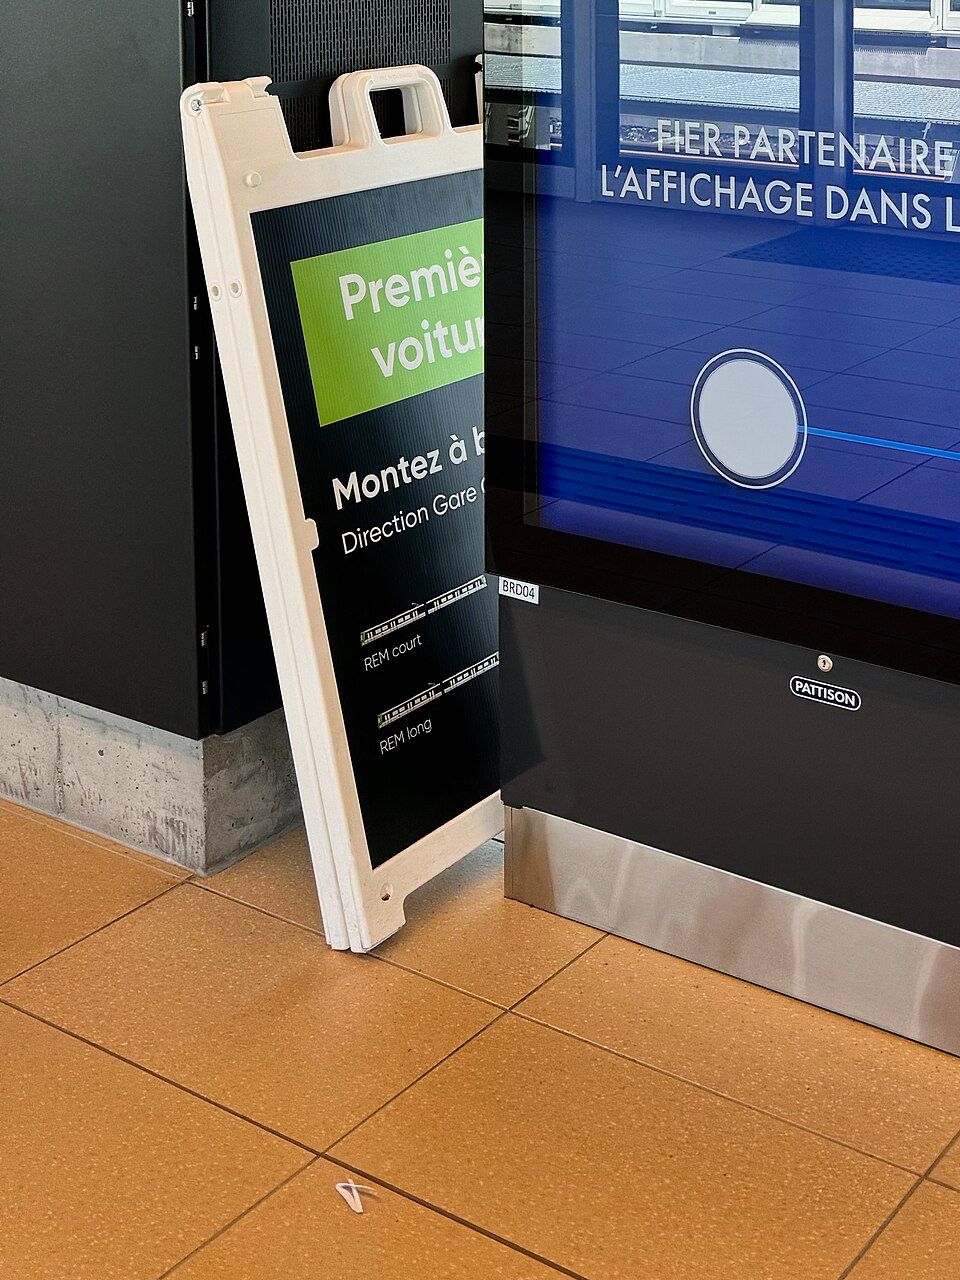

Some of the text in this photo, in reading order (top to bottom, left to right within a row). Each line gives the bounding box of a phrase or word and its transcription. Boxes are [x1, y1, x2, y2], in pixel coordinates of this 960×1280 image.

[657, 119, 721, 157] FIER
[733, 125, 953, 177] PARTENAIRE
[600, 163, 813, 219] L'AFFICHAGE
[826, 184, 932, 232] DANS
[338, 246, 484, 320] Premiè
[332, 449, 443, 510] Montez
[448, 434, 467, 465] à
[341, 486, 477, 555] Direction Gare
[502, 579, 536, 599] BRD04
[363, 634, 423, 671] REM court
[795, 679, 856, 707] PATTISON
[379, 718, 432, 755] REM long
